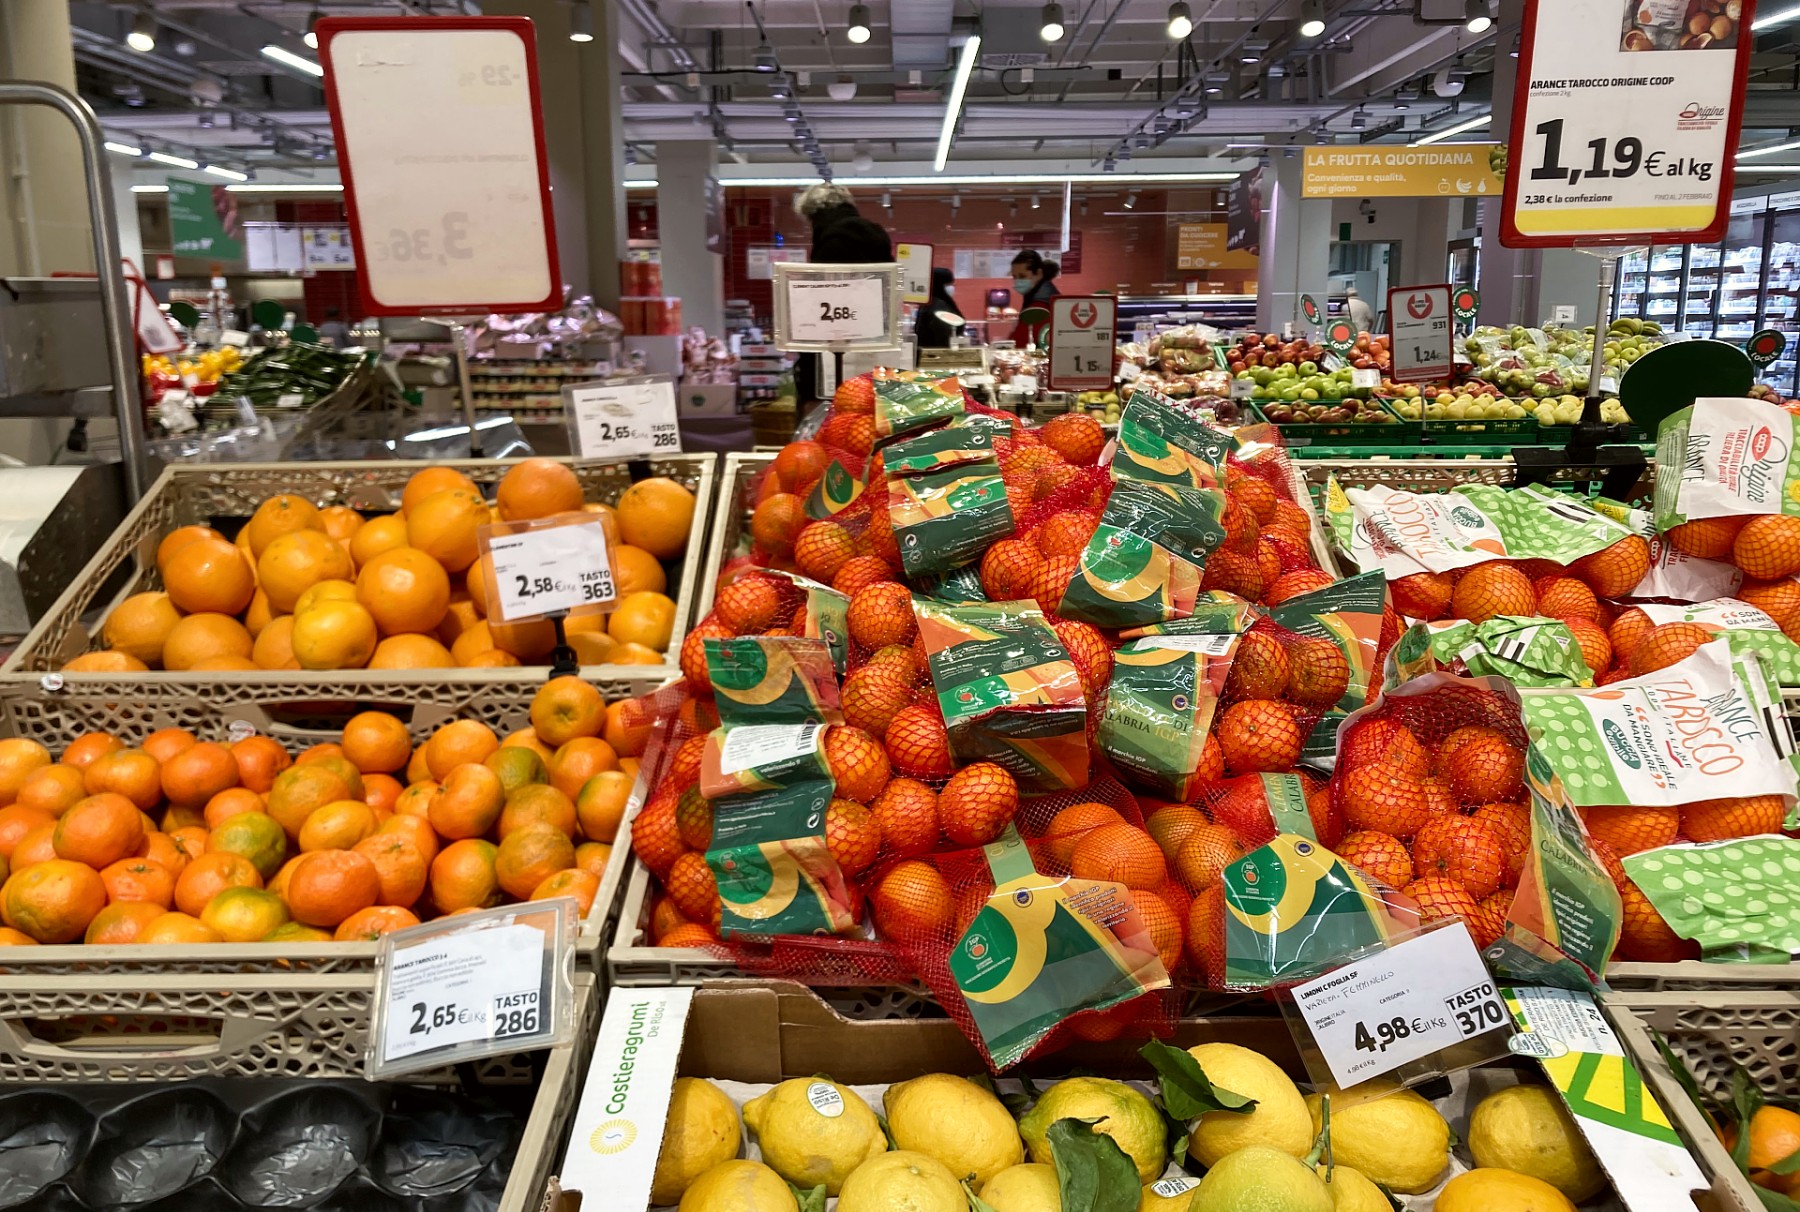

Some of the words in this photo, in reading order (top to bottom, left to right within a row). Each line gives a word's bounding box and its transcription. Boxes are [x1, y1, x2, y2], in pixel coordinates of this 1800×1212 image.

[1531, 79, 1567, 89] ARANCE
[1568, 78, 1609, 88] TAROCCO
[1611, 77, 1648, 87] ORIGINE
[1650, 76, 1675, 86] COOP
[1308, 154, 1325, 166] LA
[1329, 153, 1382, 166] FRUTTA
[1385, 152, 1474, 166] QUOTIDIANA
[1667, 158, 1685, 177] al
[1688, 157, 1713, 181] kg
[1307, 173, 1365, 183] Convenienza
[1366, 174, 1372, 182] e
[1307, 184, 1327, 195] ogni
[1328, 184, 1357, 194] giorno
[1525, 195, 1545, 204] 2,38
[1546, 196, 1553, 204] €
[1554, 194, 1563, 203] la
[1564, 193, 1613, 203] confezione
[1654, 193, 1669, 201] FINO
[1455, 307, 1478, 318] LOCALE
[1432, 320, 1447, 330] 931
[1330, 339, 1355, 351] LOCALE
[1750, 351, 1780, 362] LOCALE
[651, 424, 676, 432] TASTO
[653, 433, 678, 447] 286
[580, 570, 611, 582] TASTO
[583, 581, 613, 600] 363
[1622, 703, 1635, 717] DA
[1173, 718, 1189, 732] DI
[1153, 726, 1180, 742] IGP
[1300, 984, 1324, 1000] LIMONI
[1323, 983, 1328, 991] C
[1327, 975, 1351, 989] FOGLIA
[1349, 970, 1359, 980] SF
[495, 991, 538, 1010] TASTO
[1379, 990, 1406, 1005] CATEGORIA
[1446, 983, 1493, 1011] TASTO
[494, 1007, 537, 1036] 286
[1455, 999, 1504, 1036] 370
[646, 1024, 660, 1038] De
[605, 1000, 651, 1115] Costieragrumi
